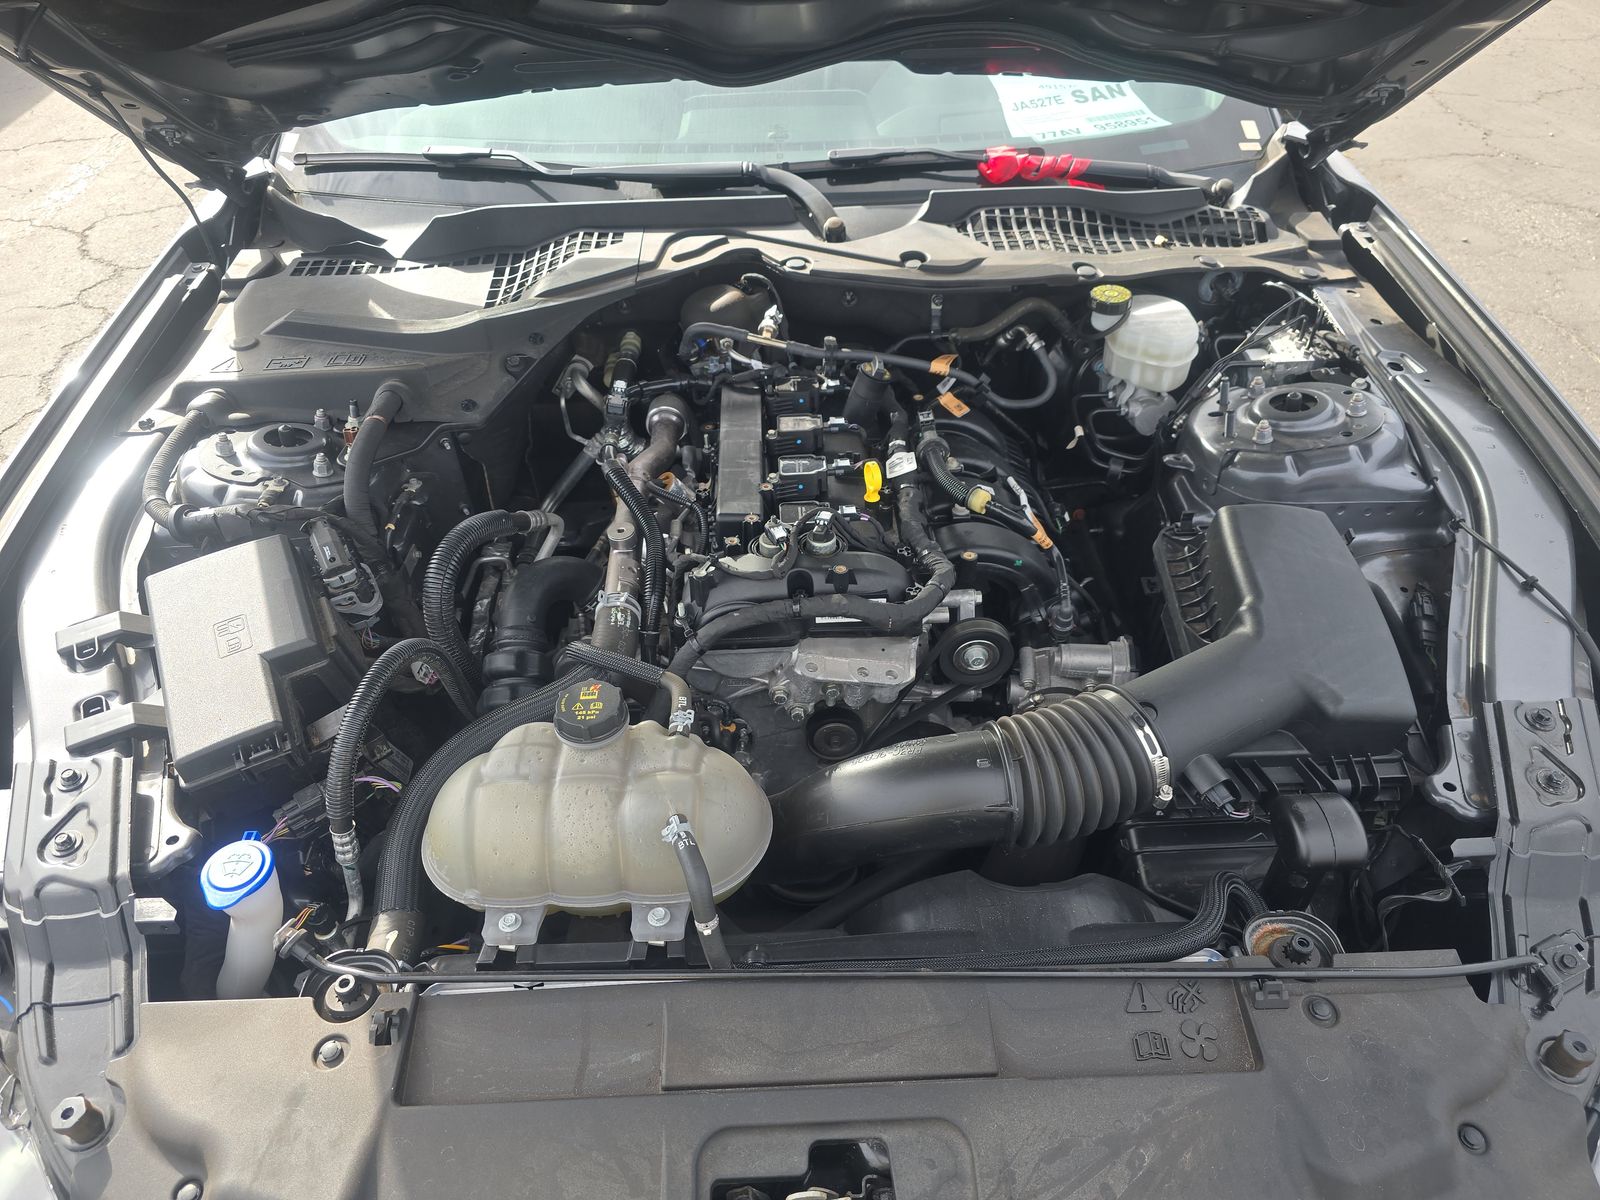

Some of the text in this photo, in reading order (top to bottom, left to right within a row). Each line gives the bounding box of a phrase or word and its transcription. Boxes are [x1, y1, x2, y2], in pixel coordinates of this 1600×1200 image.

[1012, 83, 1127, 112] JA527E SAN
[677, 838, 696, 850] BTL
